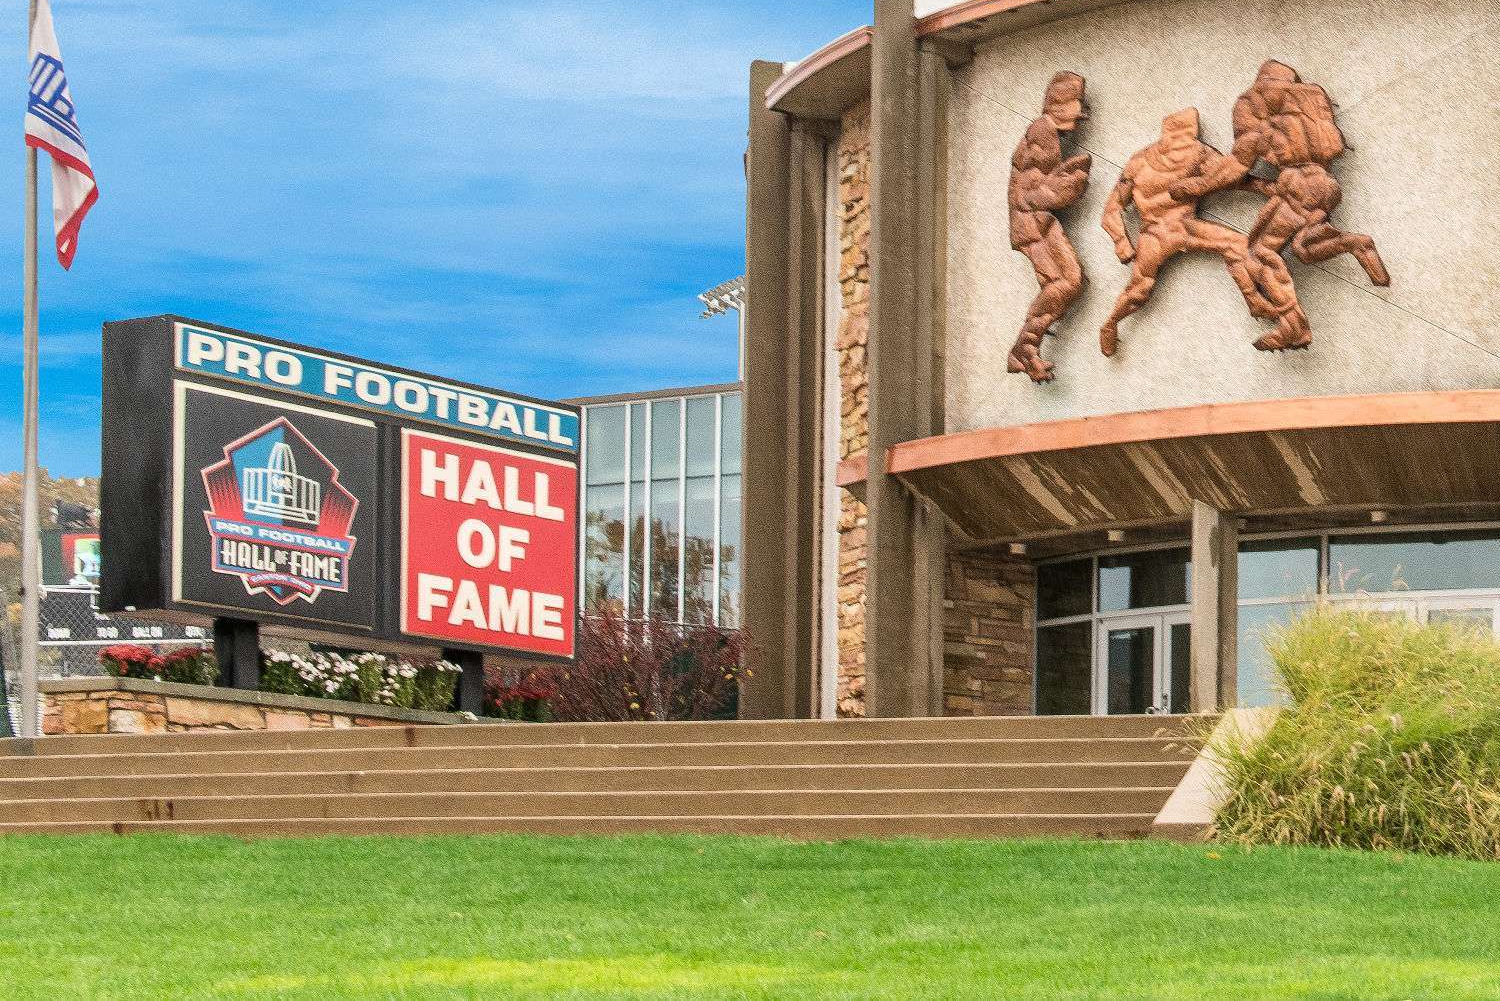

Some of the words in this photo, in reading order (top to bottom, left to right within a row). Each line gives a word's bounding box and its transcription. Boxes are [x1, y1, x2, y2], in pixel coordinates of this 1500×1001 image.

[187, 332, 303, 386] PRO
[324, 363, 574, 446] FOOTBALL
[420, 448, 565, 522] HALL
[215, 521, 253, 537] PRO
[258, 529, 346, 552] FOOTBALL
[221, 539, 277, 573] HALL
[274, 549, 289, 565] OF
[288, 550, 341, 583] FAME
[456, 518, 530, 572] OF
[417, 572, 565, 641] FAME
